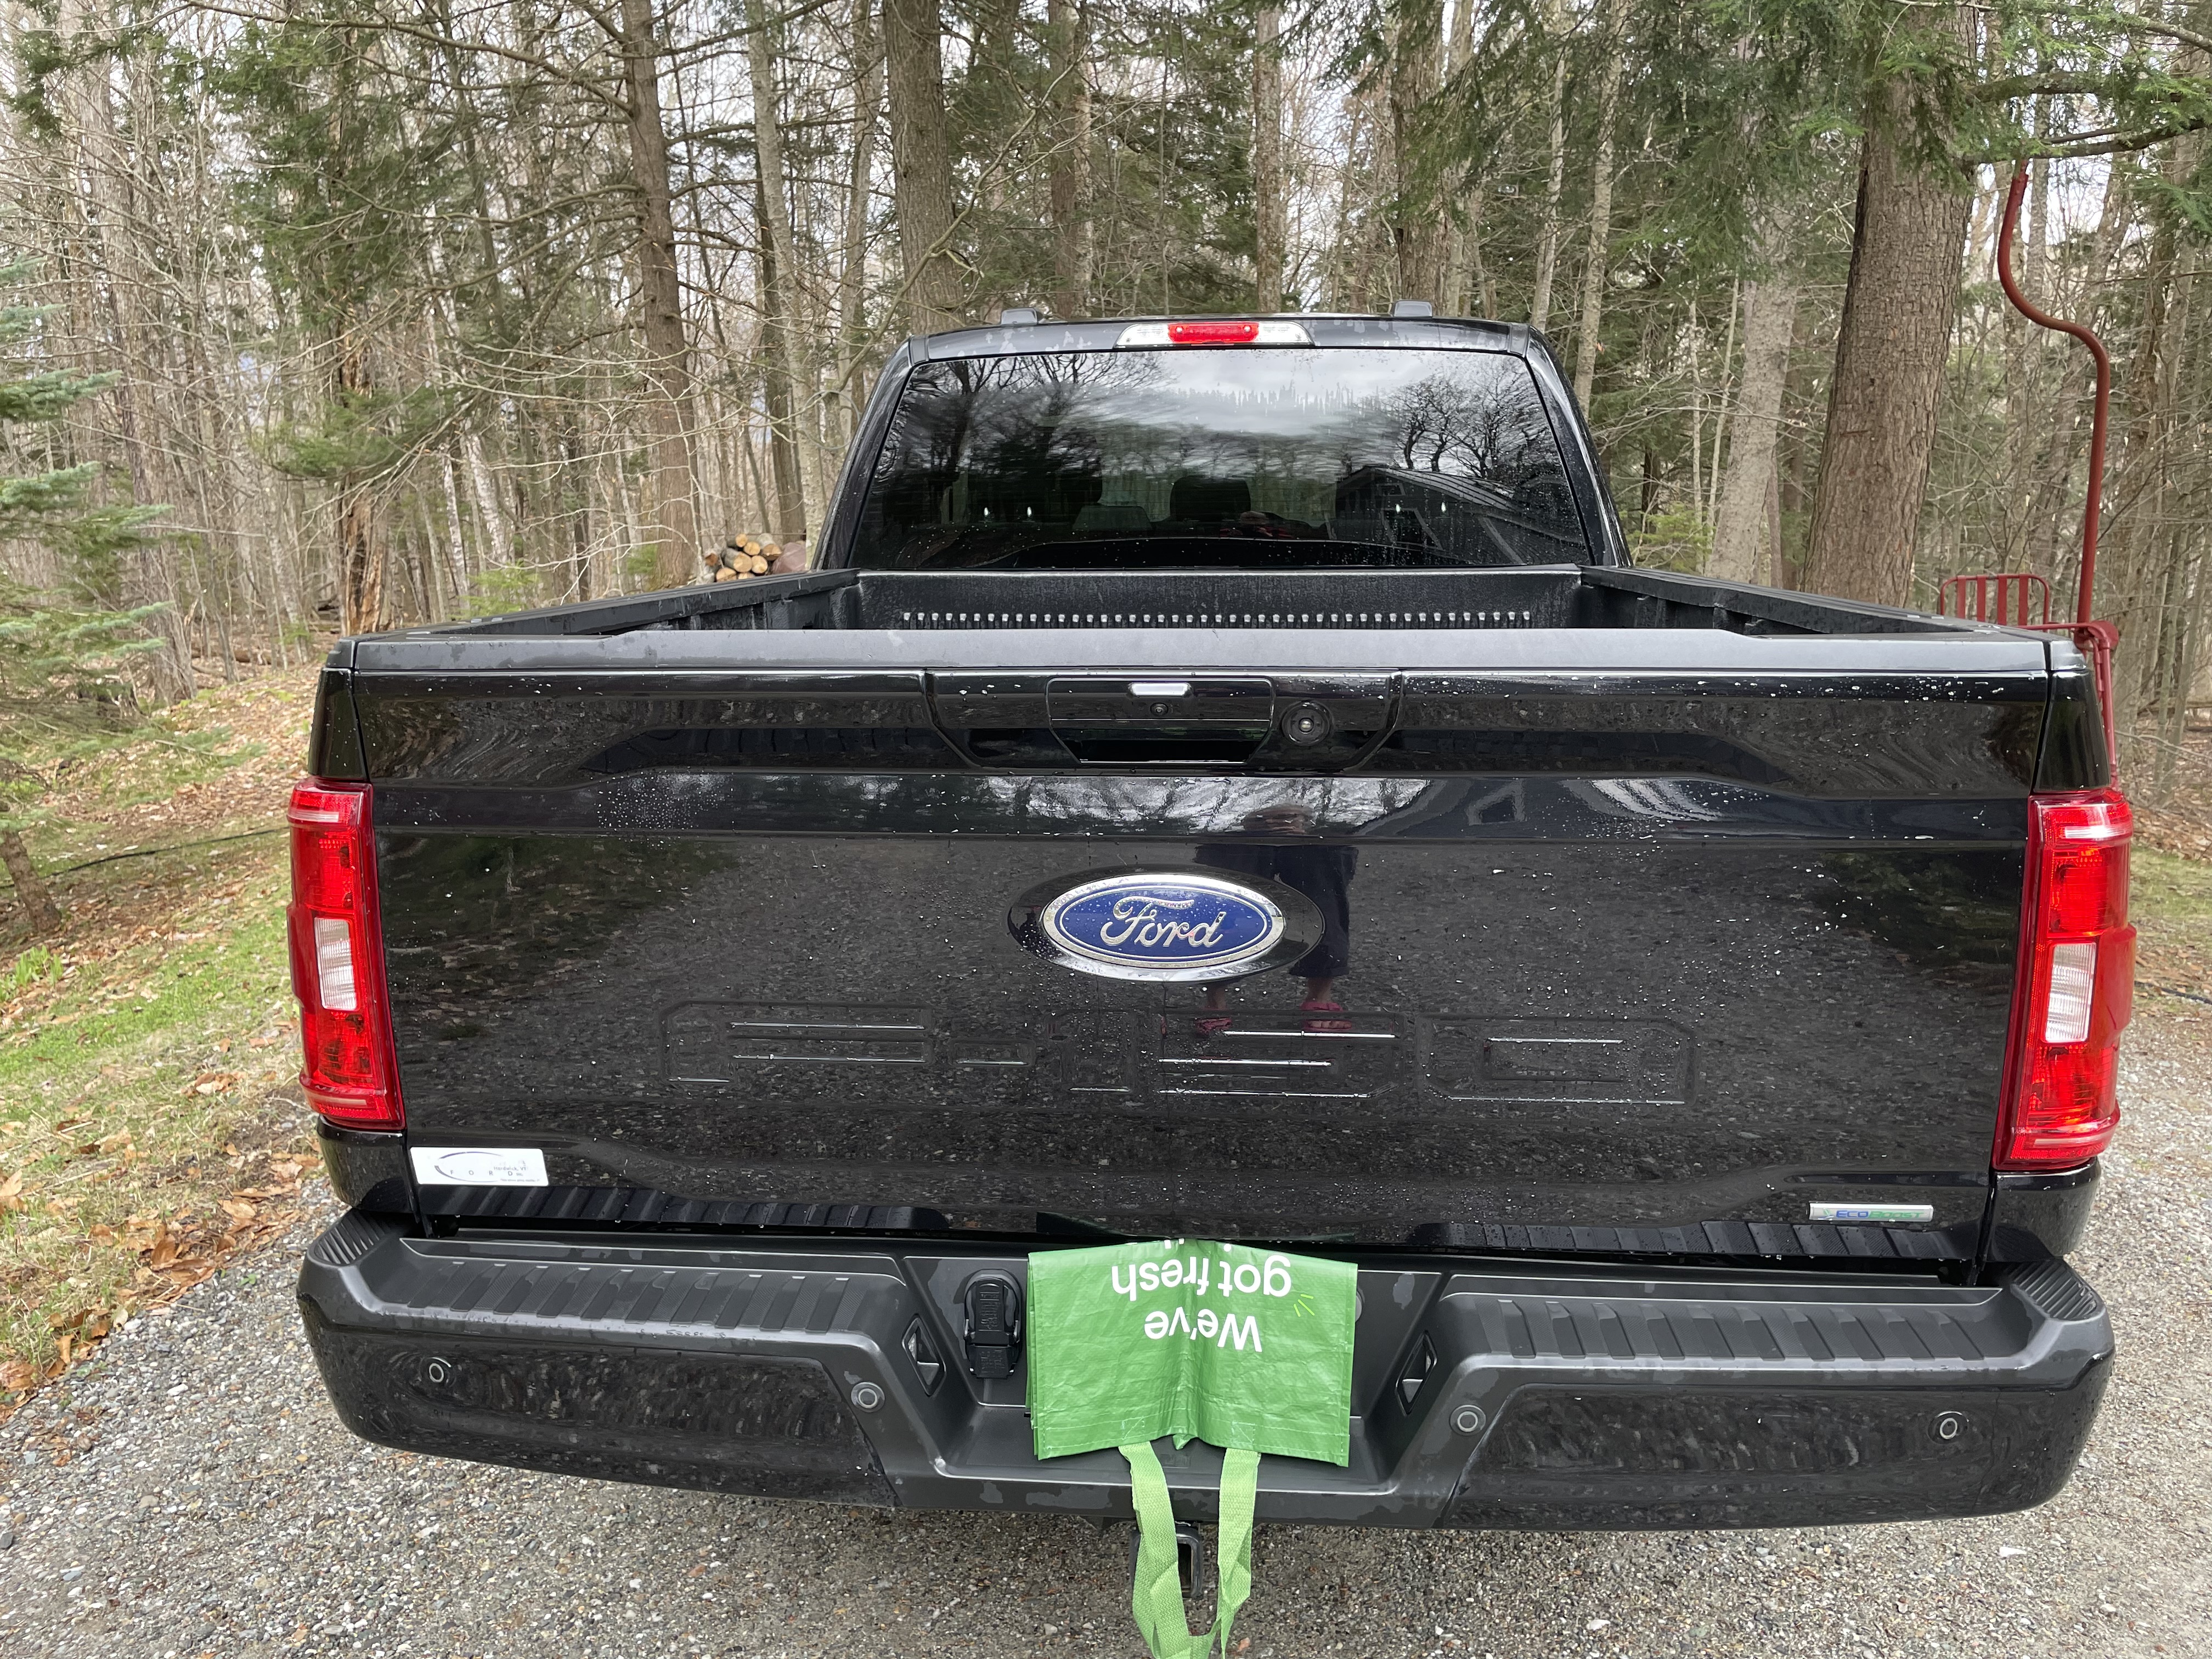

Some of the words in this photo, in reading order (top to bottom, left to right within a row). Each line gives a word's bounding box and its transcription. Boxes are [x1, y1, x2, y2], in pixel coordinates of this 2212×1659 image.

[1101, 896, 1226, 947] Ford
[1111, 1256, 1210, 1301] fresh
[1217, 1255, 1292, 1297] got
[1144, 1306, 1262, 1352] We've
